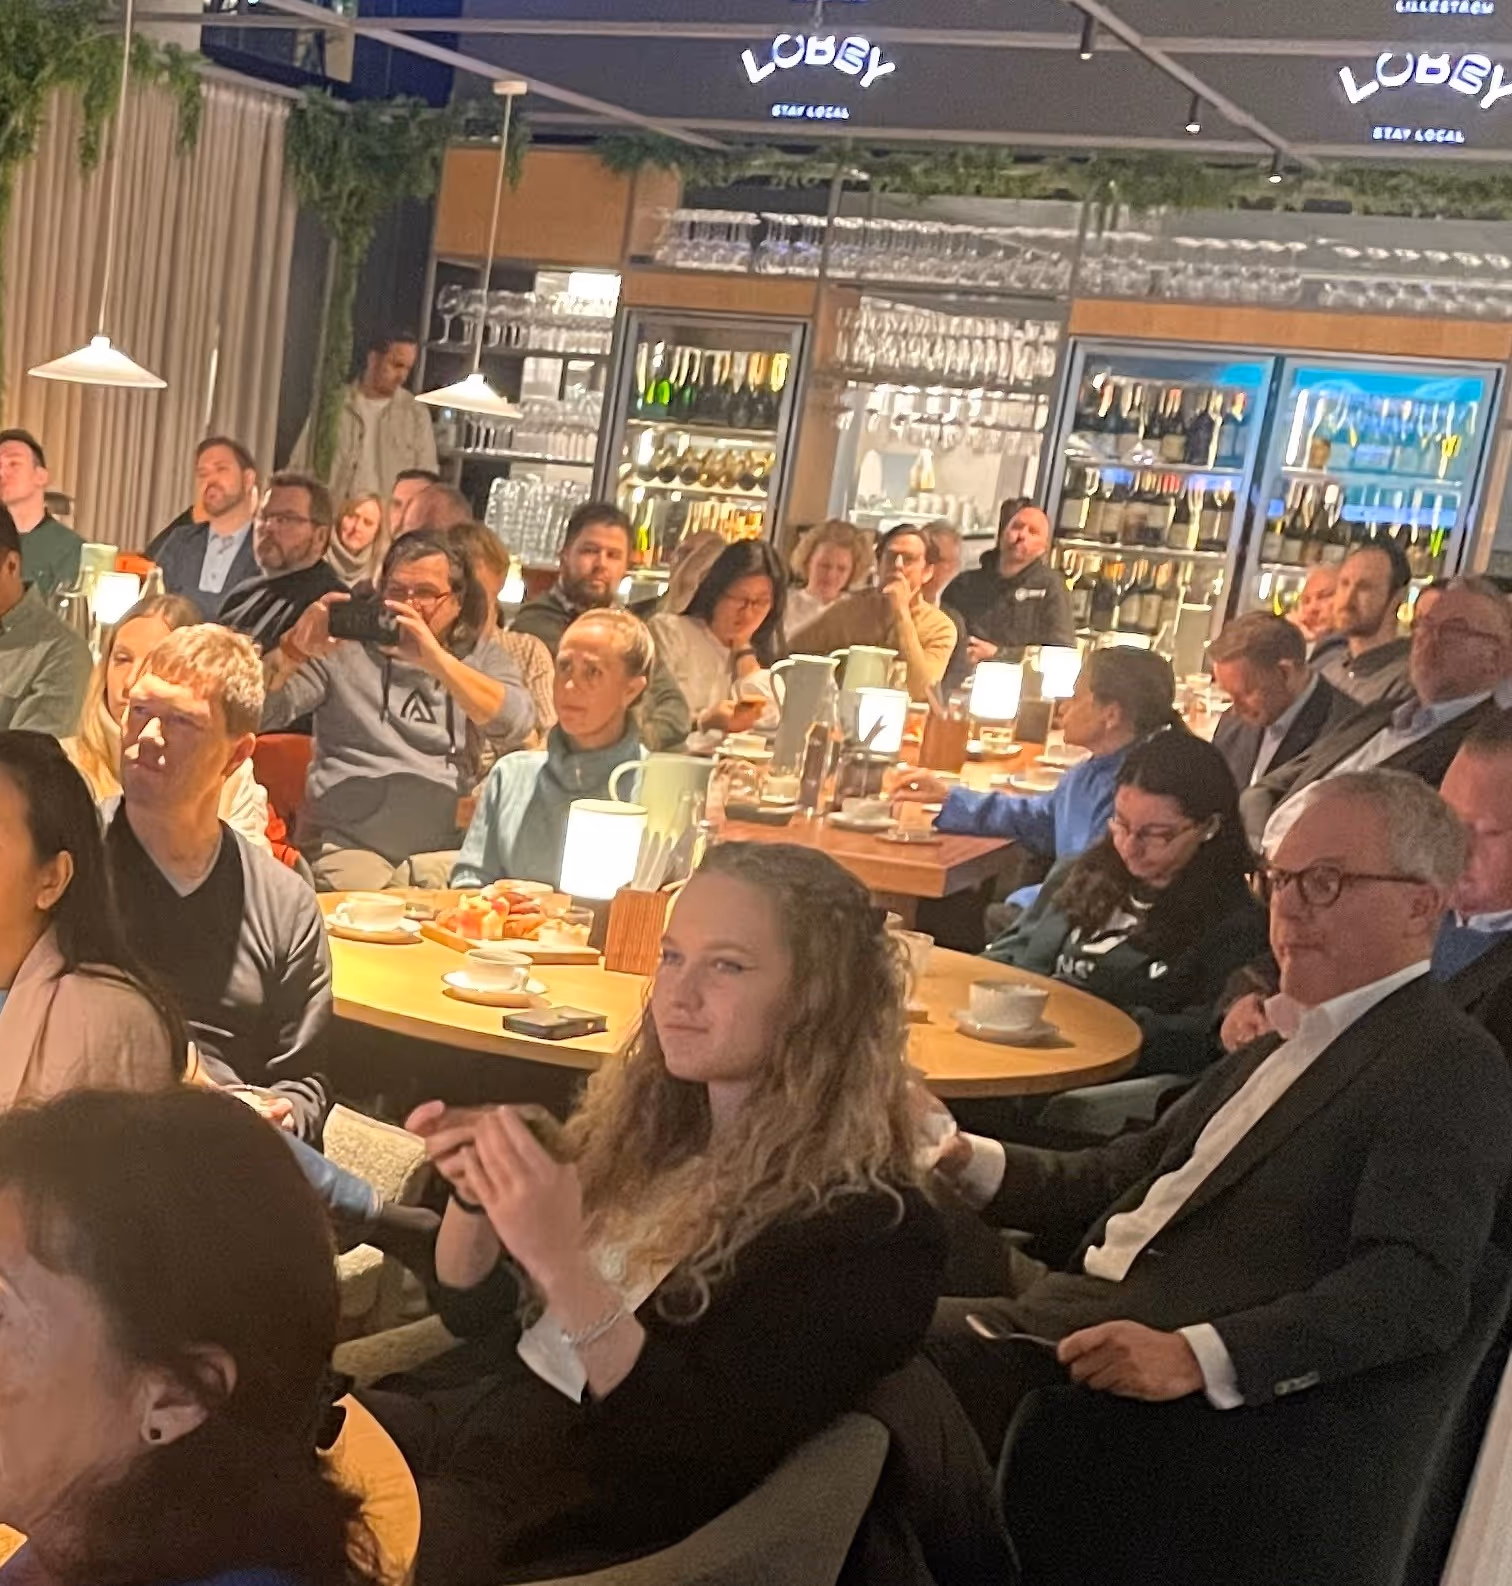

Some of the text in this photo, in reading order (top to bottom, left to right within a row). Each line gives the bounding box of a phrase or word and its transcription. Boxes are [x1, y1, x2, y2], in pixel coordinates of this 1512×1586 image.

[740, 33, 896, 88] LOBBY
[1338, 52, 1512, 110] LOBBY
[771, 104, 850, 119] STAY LOCAL
[1372, 126, 1466, 143] STAY LOCAL
